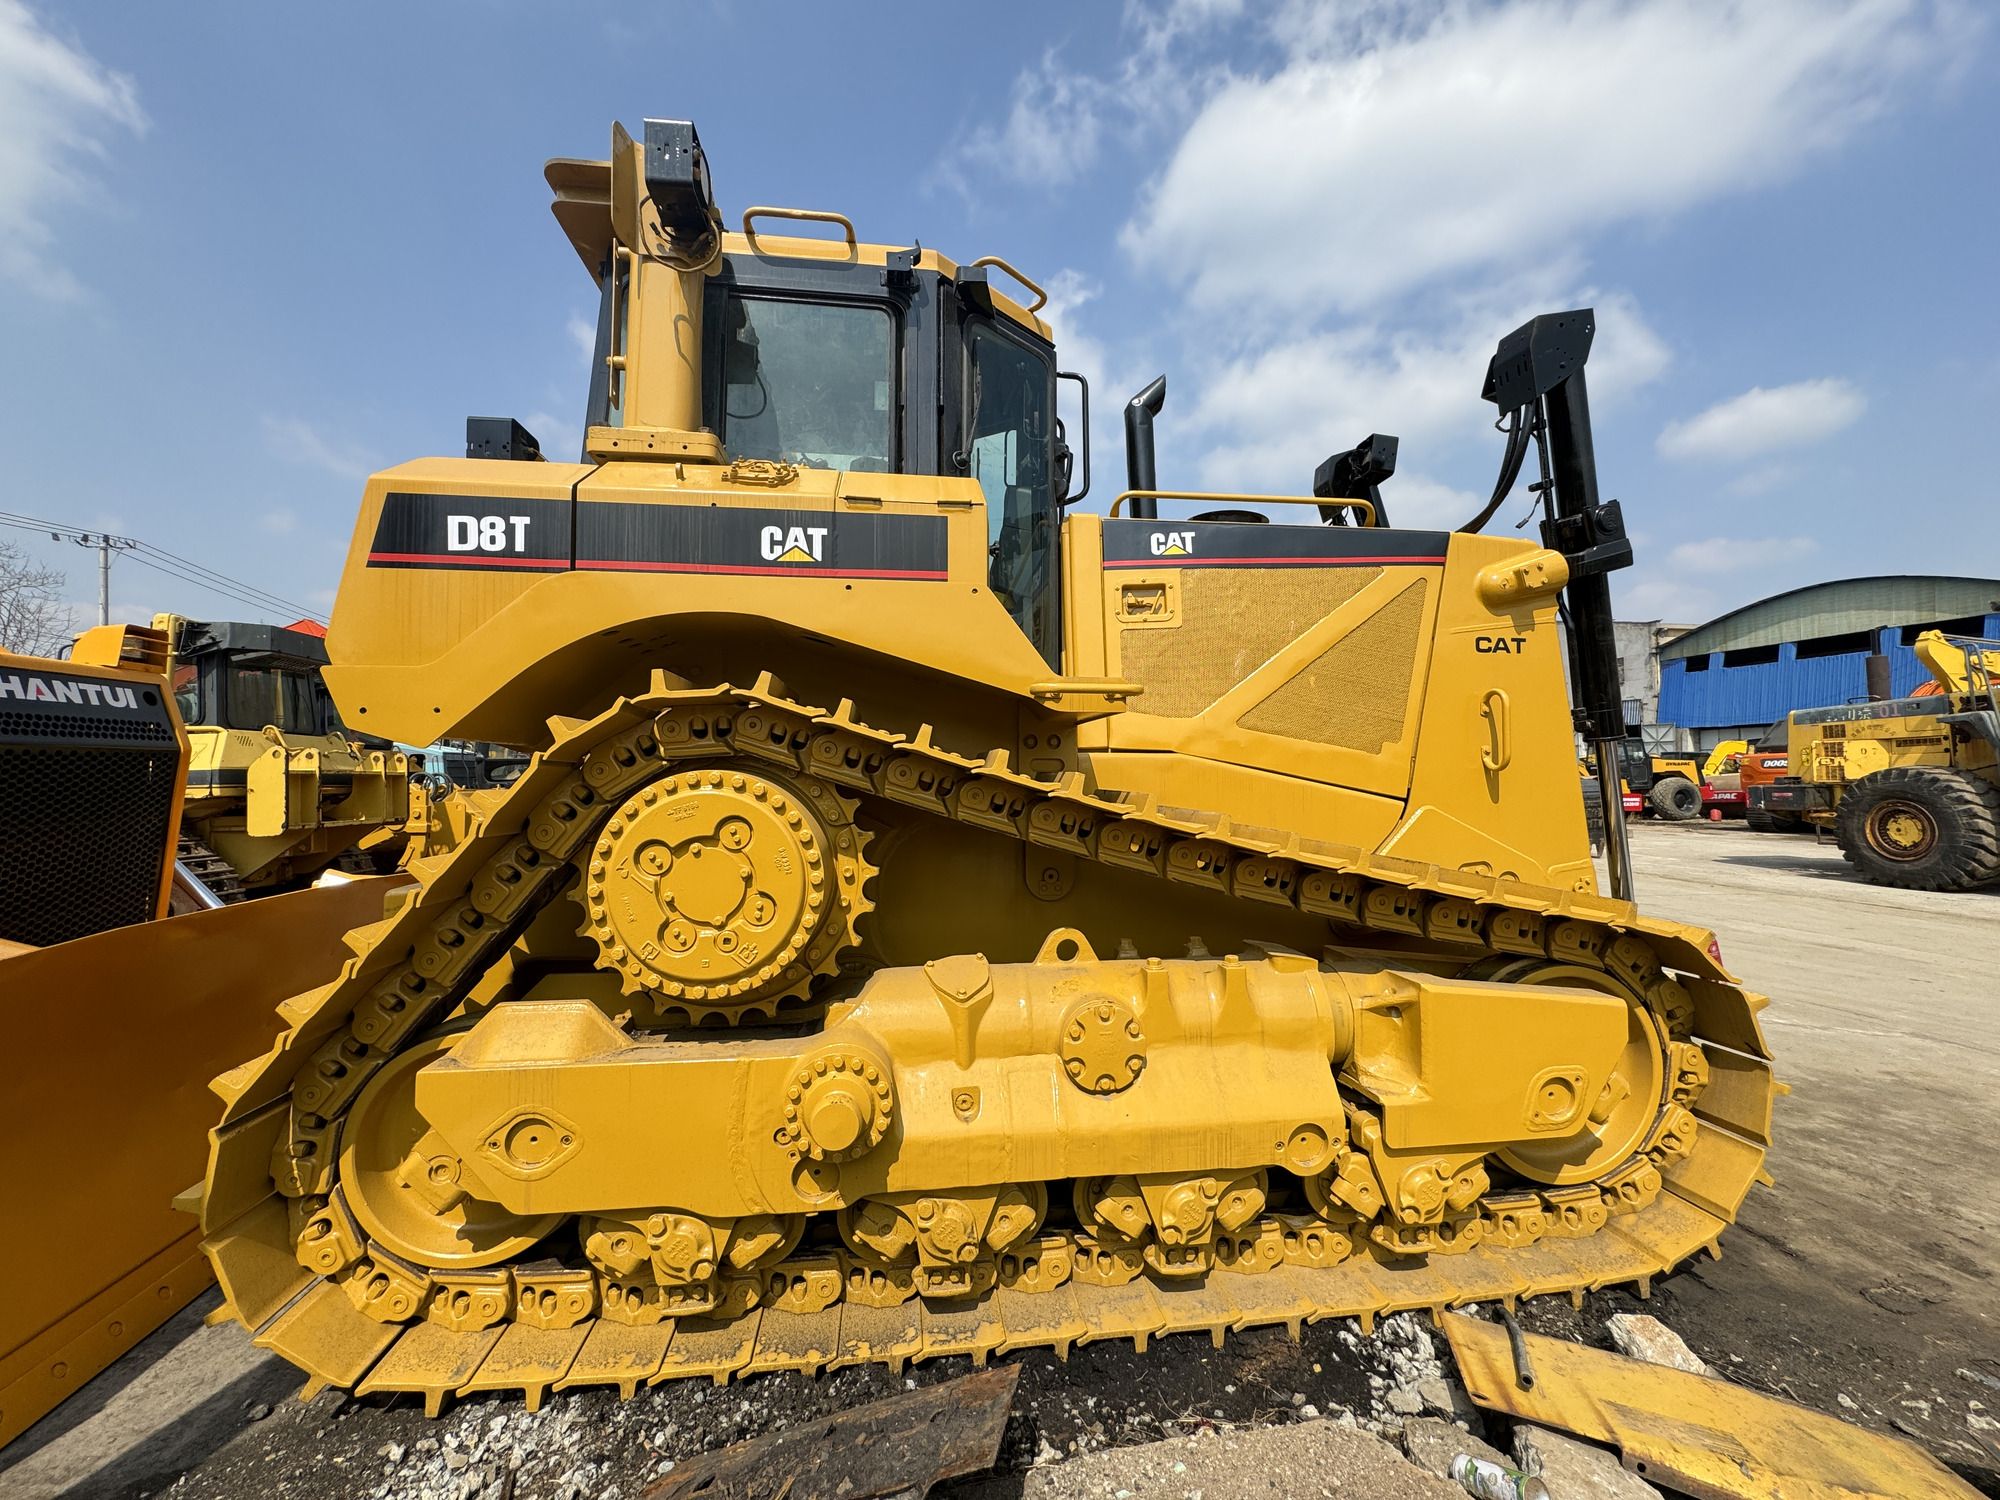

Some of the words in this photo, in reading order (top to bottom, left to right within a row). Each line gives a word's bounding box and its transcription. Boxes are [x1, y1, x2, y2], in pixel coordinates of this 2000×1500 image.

[447, 515, 531, 552] D8T
[761, 525, 828, 562] CAT
[1150, 531, 1196, 556] CAT
[1475, 636, 1527, 654] CAT
